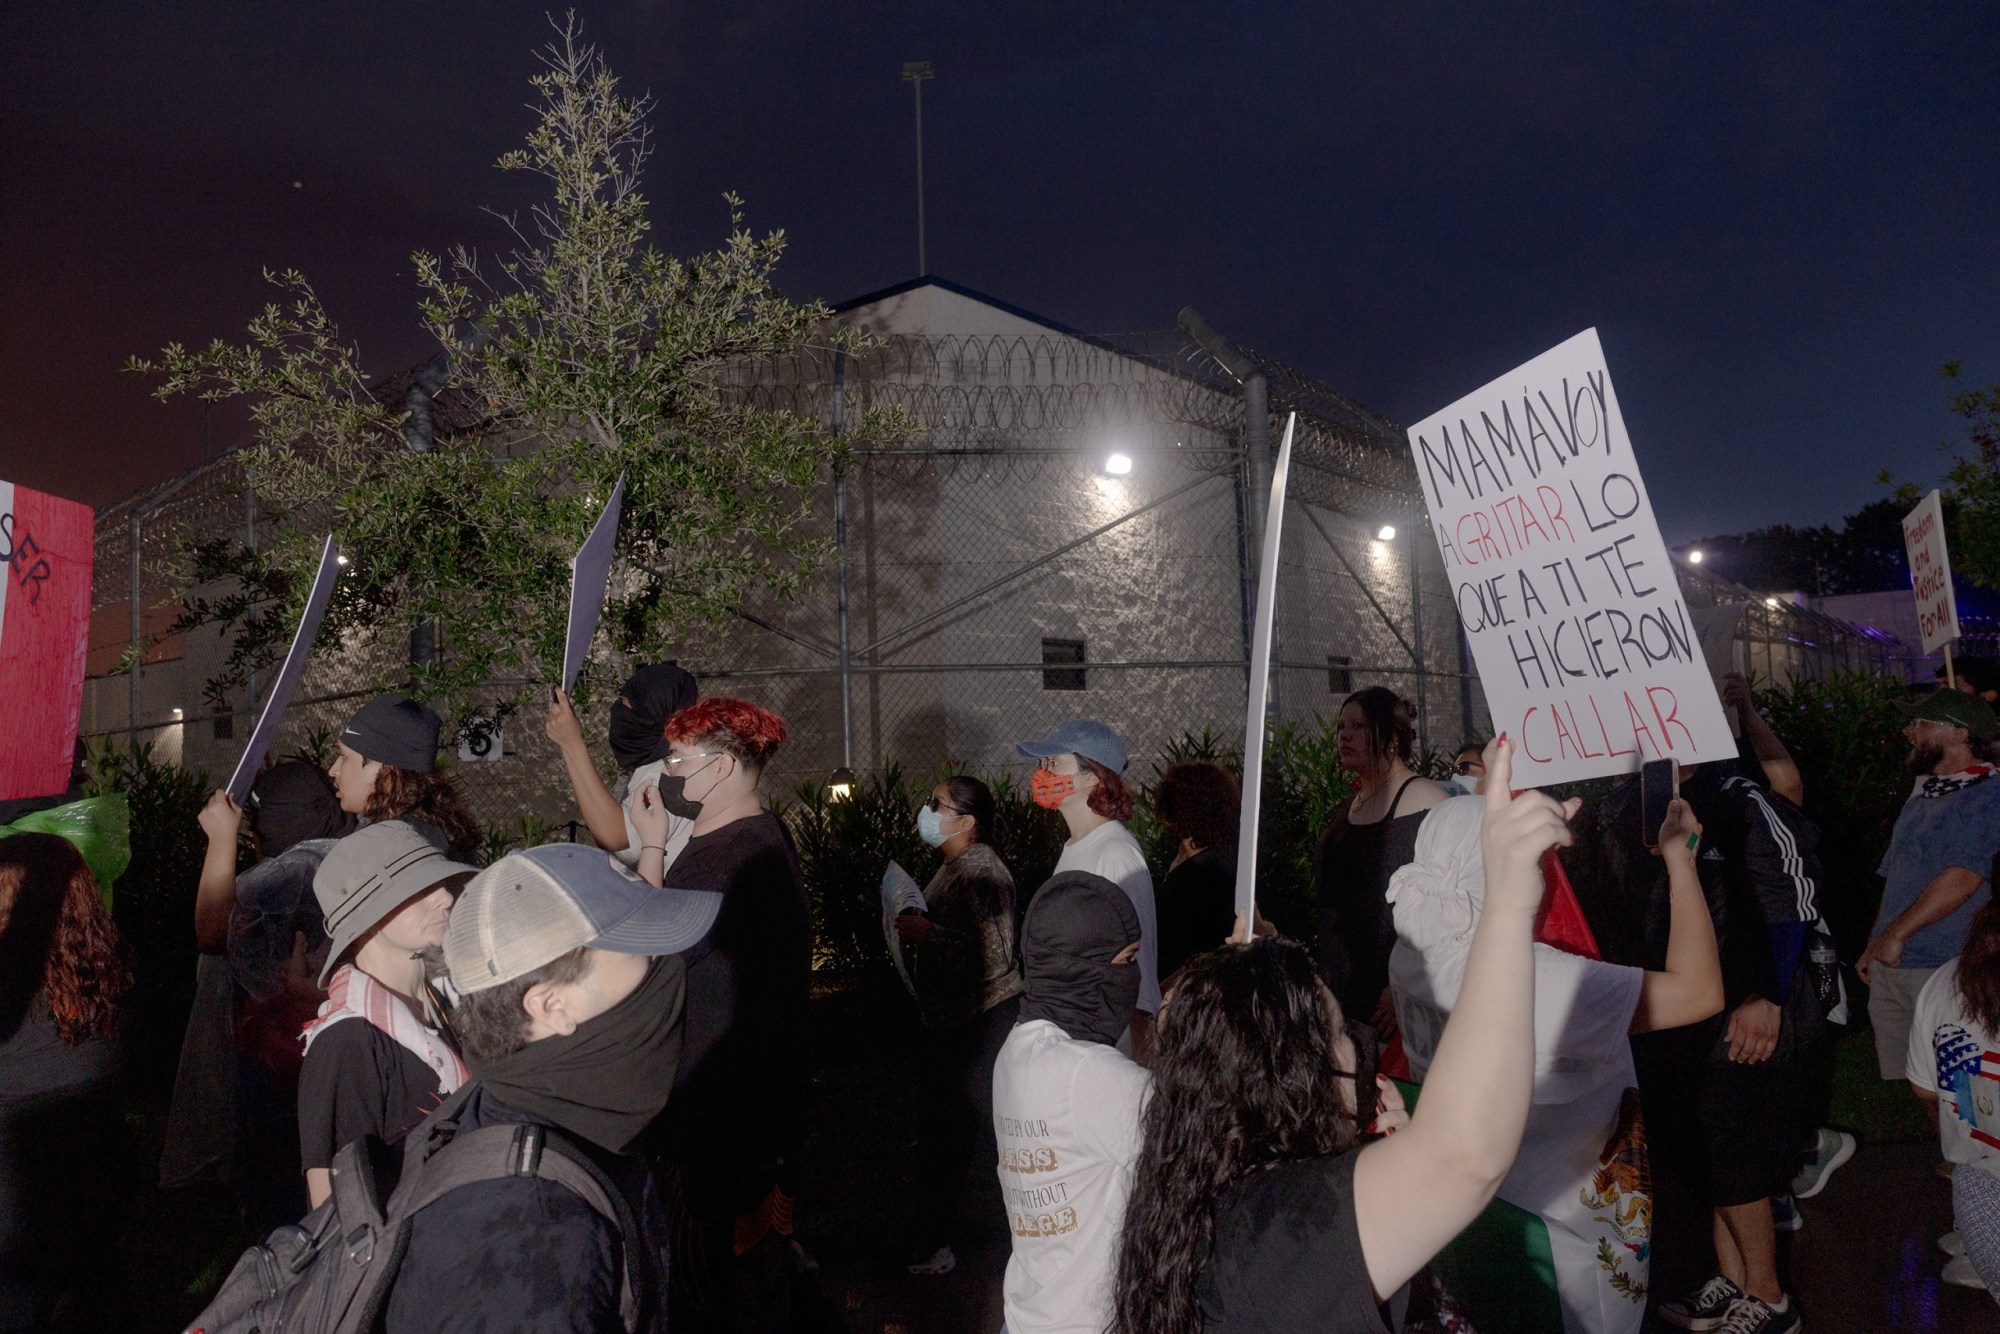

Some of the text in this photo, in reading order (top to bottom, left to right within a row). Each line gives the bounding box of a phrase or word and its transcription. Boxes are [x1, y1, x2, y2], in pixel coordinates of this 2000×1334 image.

[1440, 473, 1640, 568] A GRITAR LO
[1915, 541, 1930, 571] and
[1457, 534, 1658, 634] QUE A TI TE
[1507, 600, 1693, 689] HICIERON
[1522, 686, 1698, 763] CALLAR
[1024, 1119, 1050, 1138] OUR
